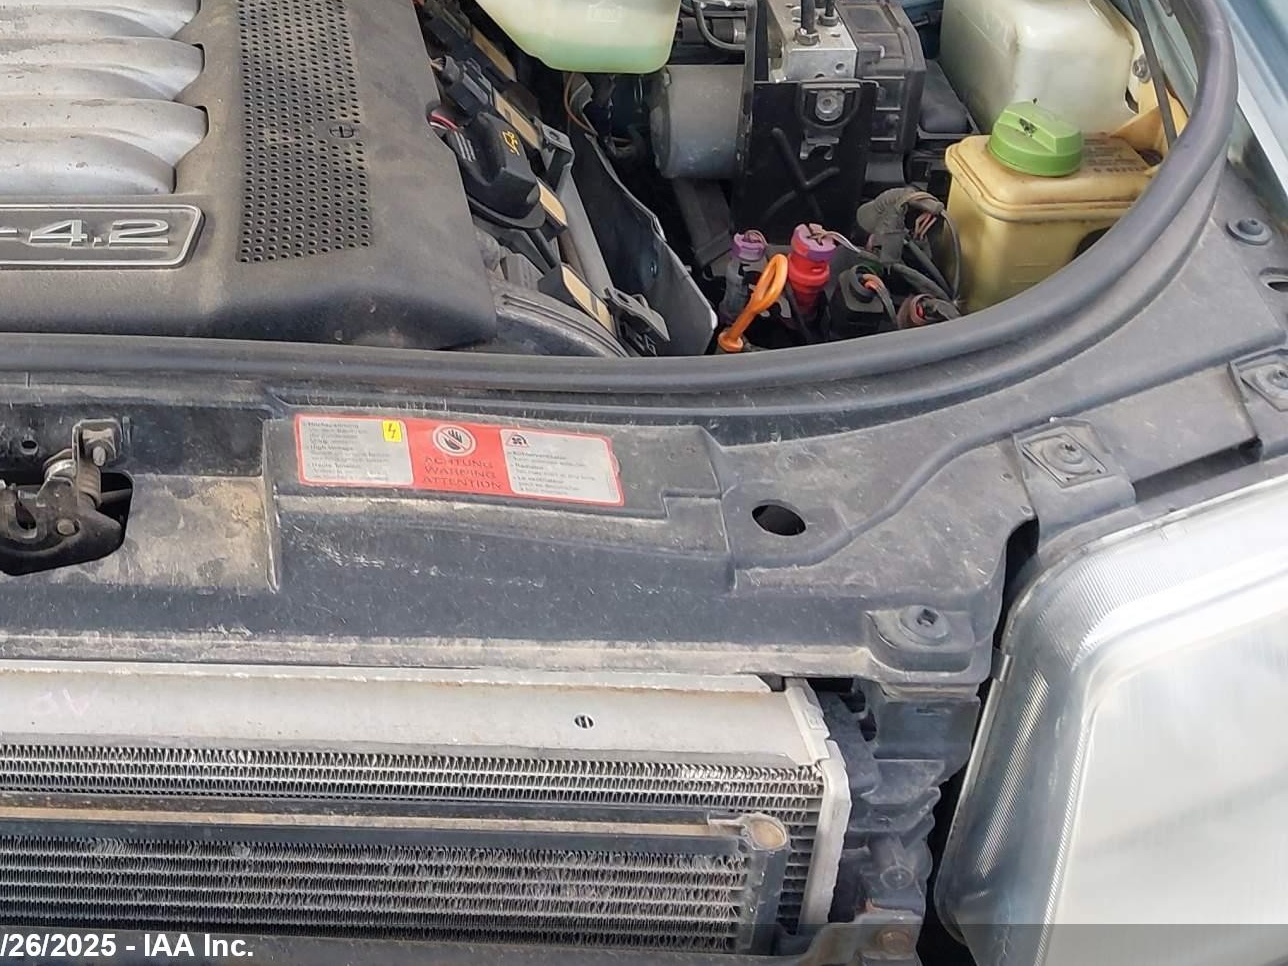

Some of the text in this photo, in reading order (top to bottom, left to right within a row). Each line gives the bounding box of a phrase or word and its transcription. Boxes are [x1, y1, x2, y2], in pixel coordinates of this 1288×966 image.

[425, 456, 493, 468] ACHTUNG
[425, 466, 496, 478] WARNING
[424, 476, 503, 490] ATTENTION
